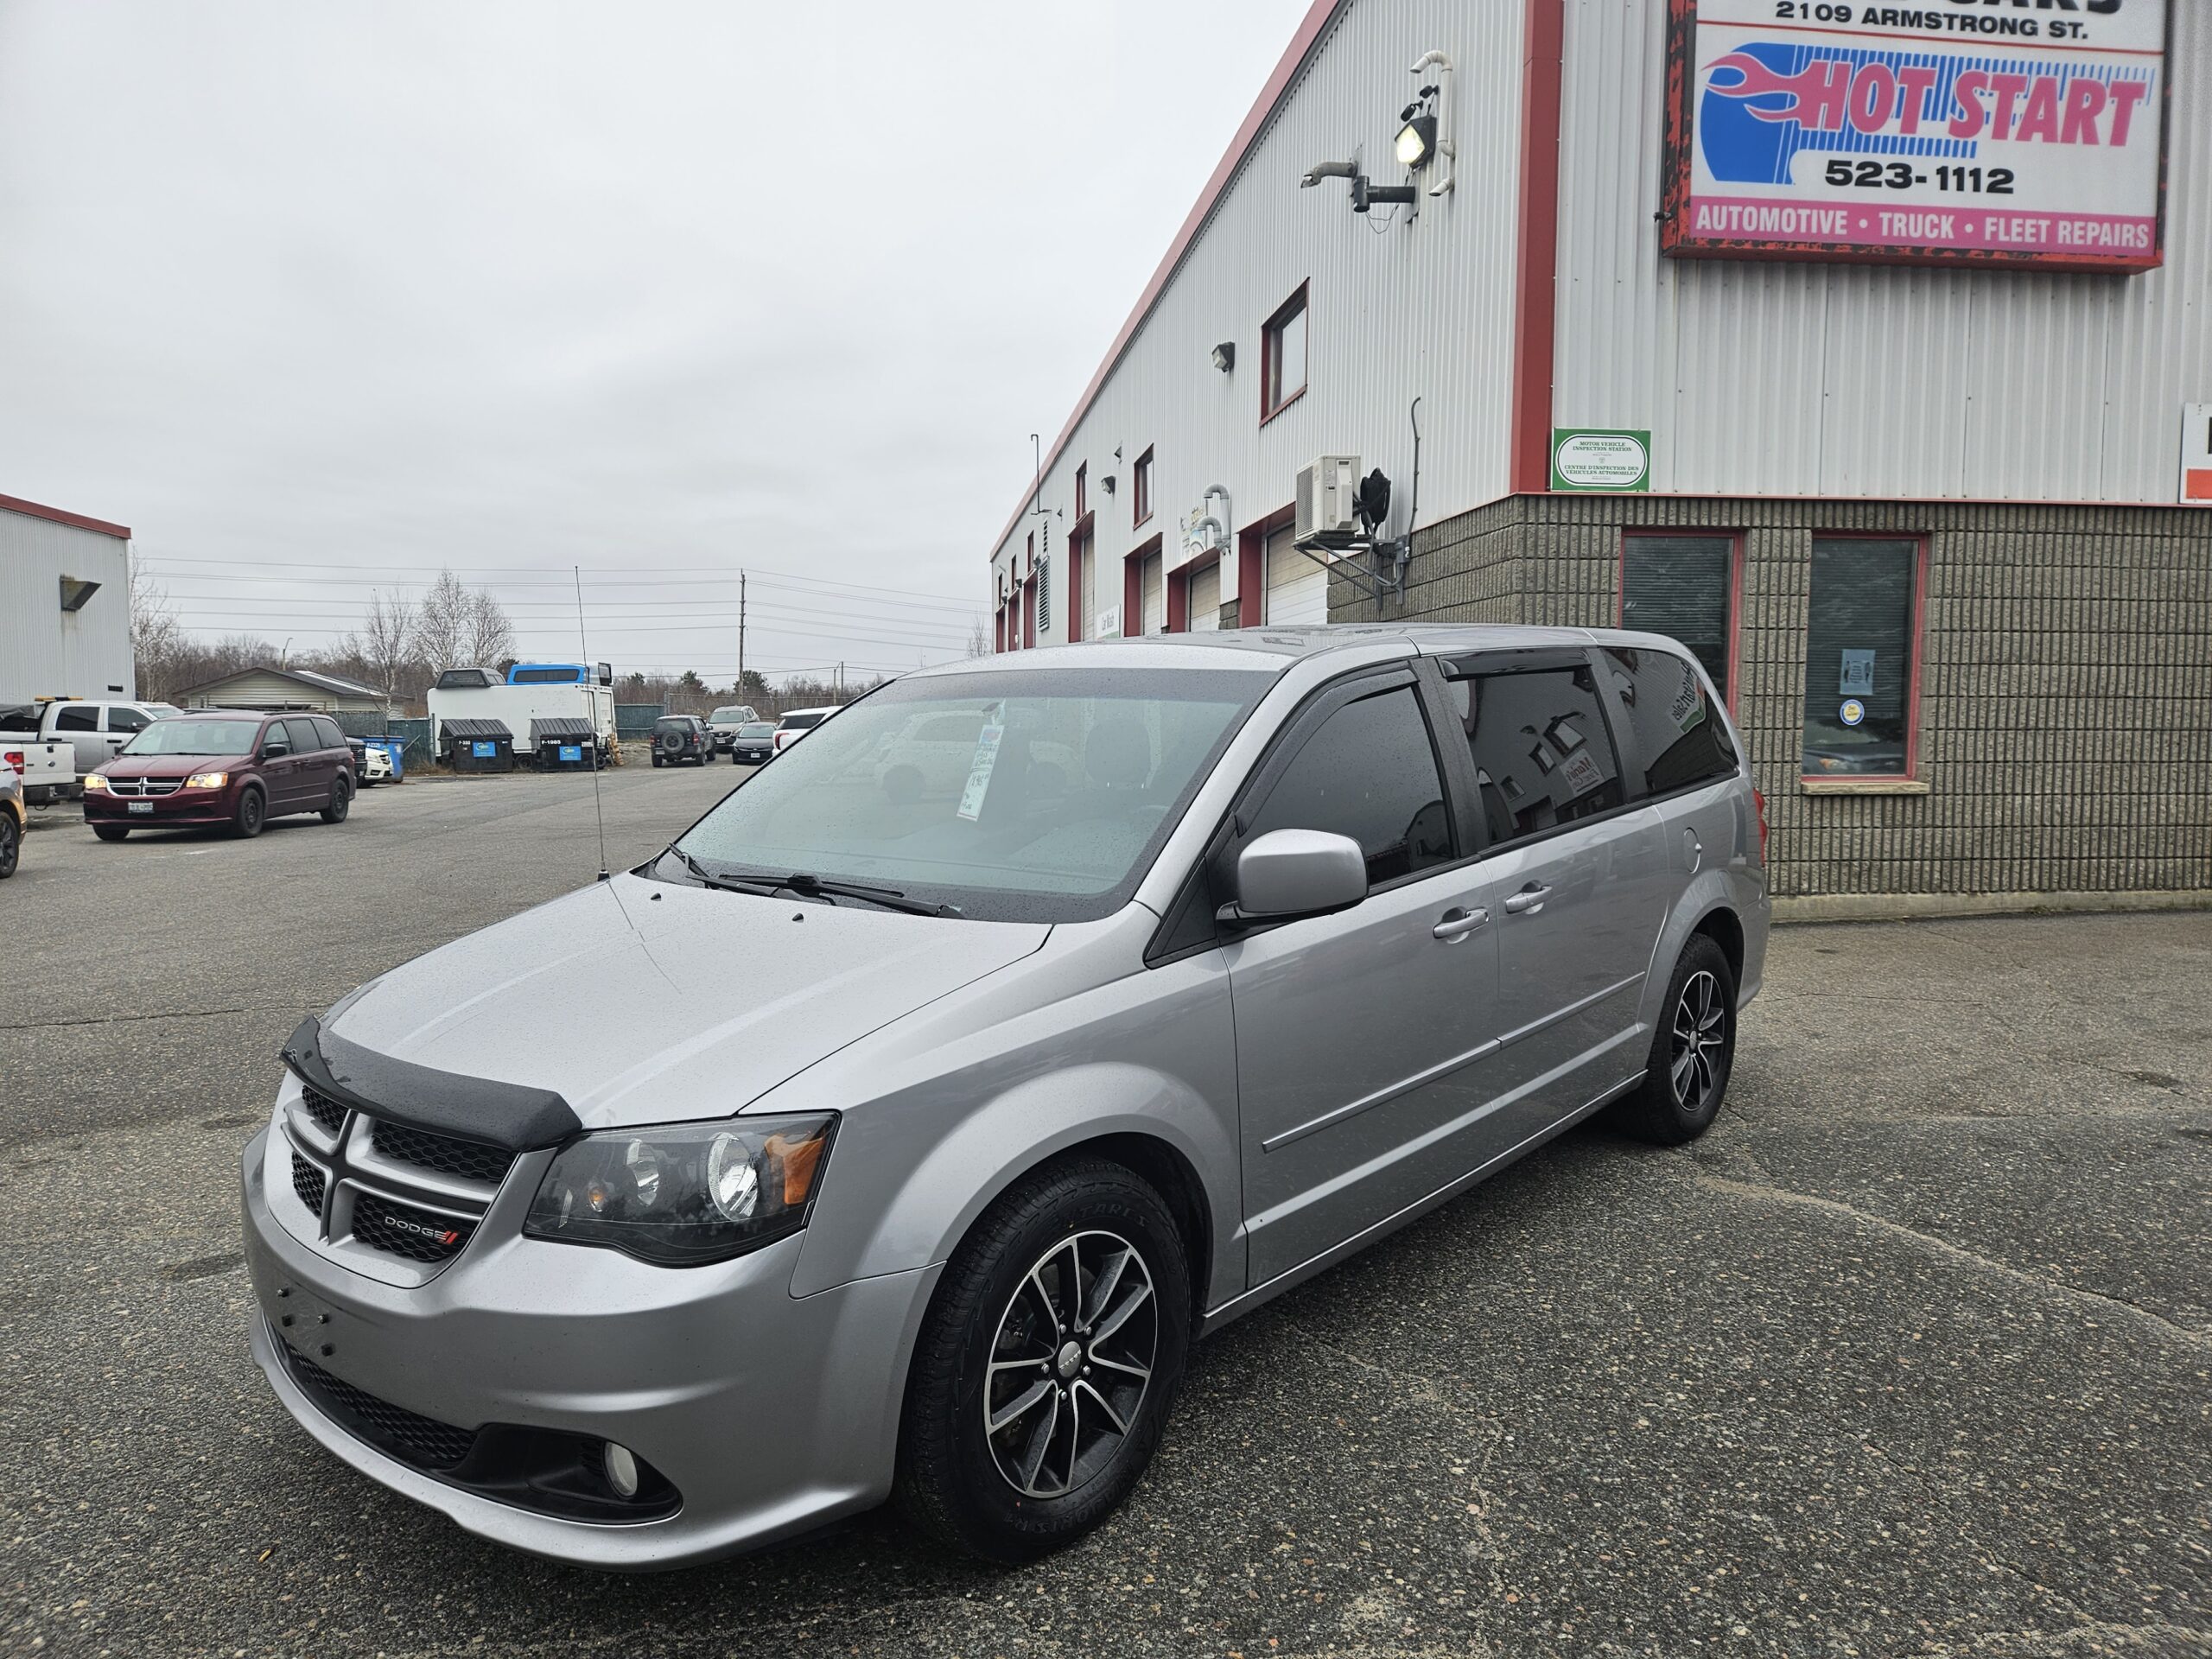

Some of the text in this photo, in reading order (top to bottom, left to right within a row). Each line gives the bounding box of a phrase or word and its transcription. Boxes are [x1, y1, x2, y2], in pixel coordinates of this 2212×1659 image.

[1776, 1, 1852, 22] 2109
[1861, 7, 2038, 36] ARMSTRONG
[2049, 20, 2088, 39] ST.
[1799, 60, 2146, 147] HOT START
[1695, 205, 2150, 249] AUTOMOTIVE TRUCK FLEET REPAIRS
[385, 1216, 448, 1241] DODGE
